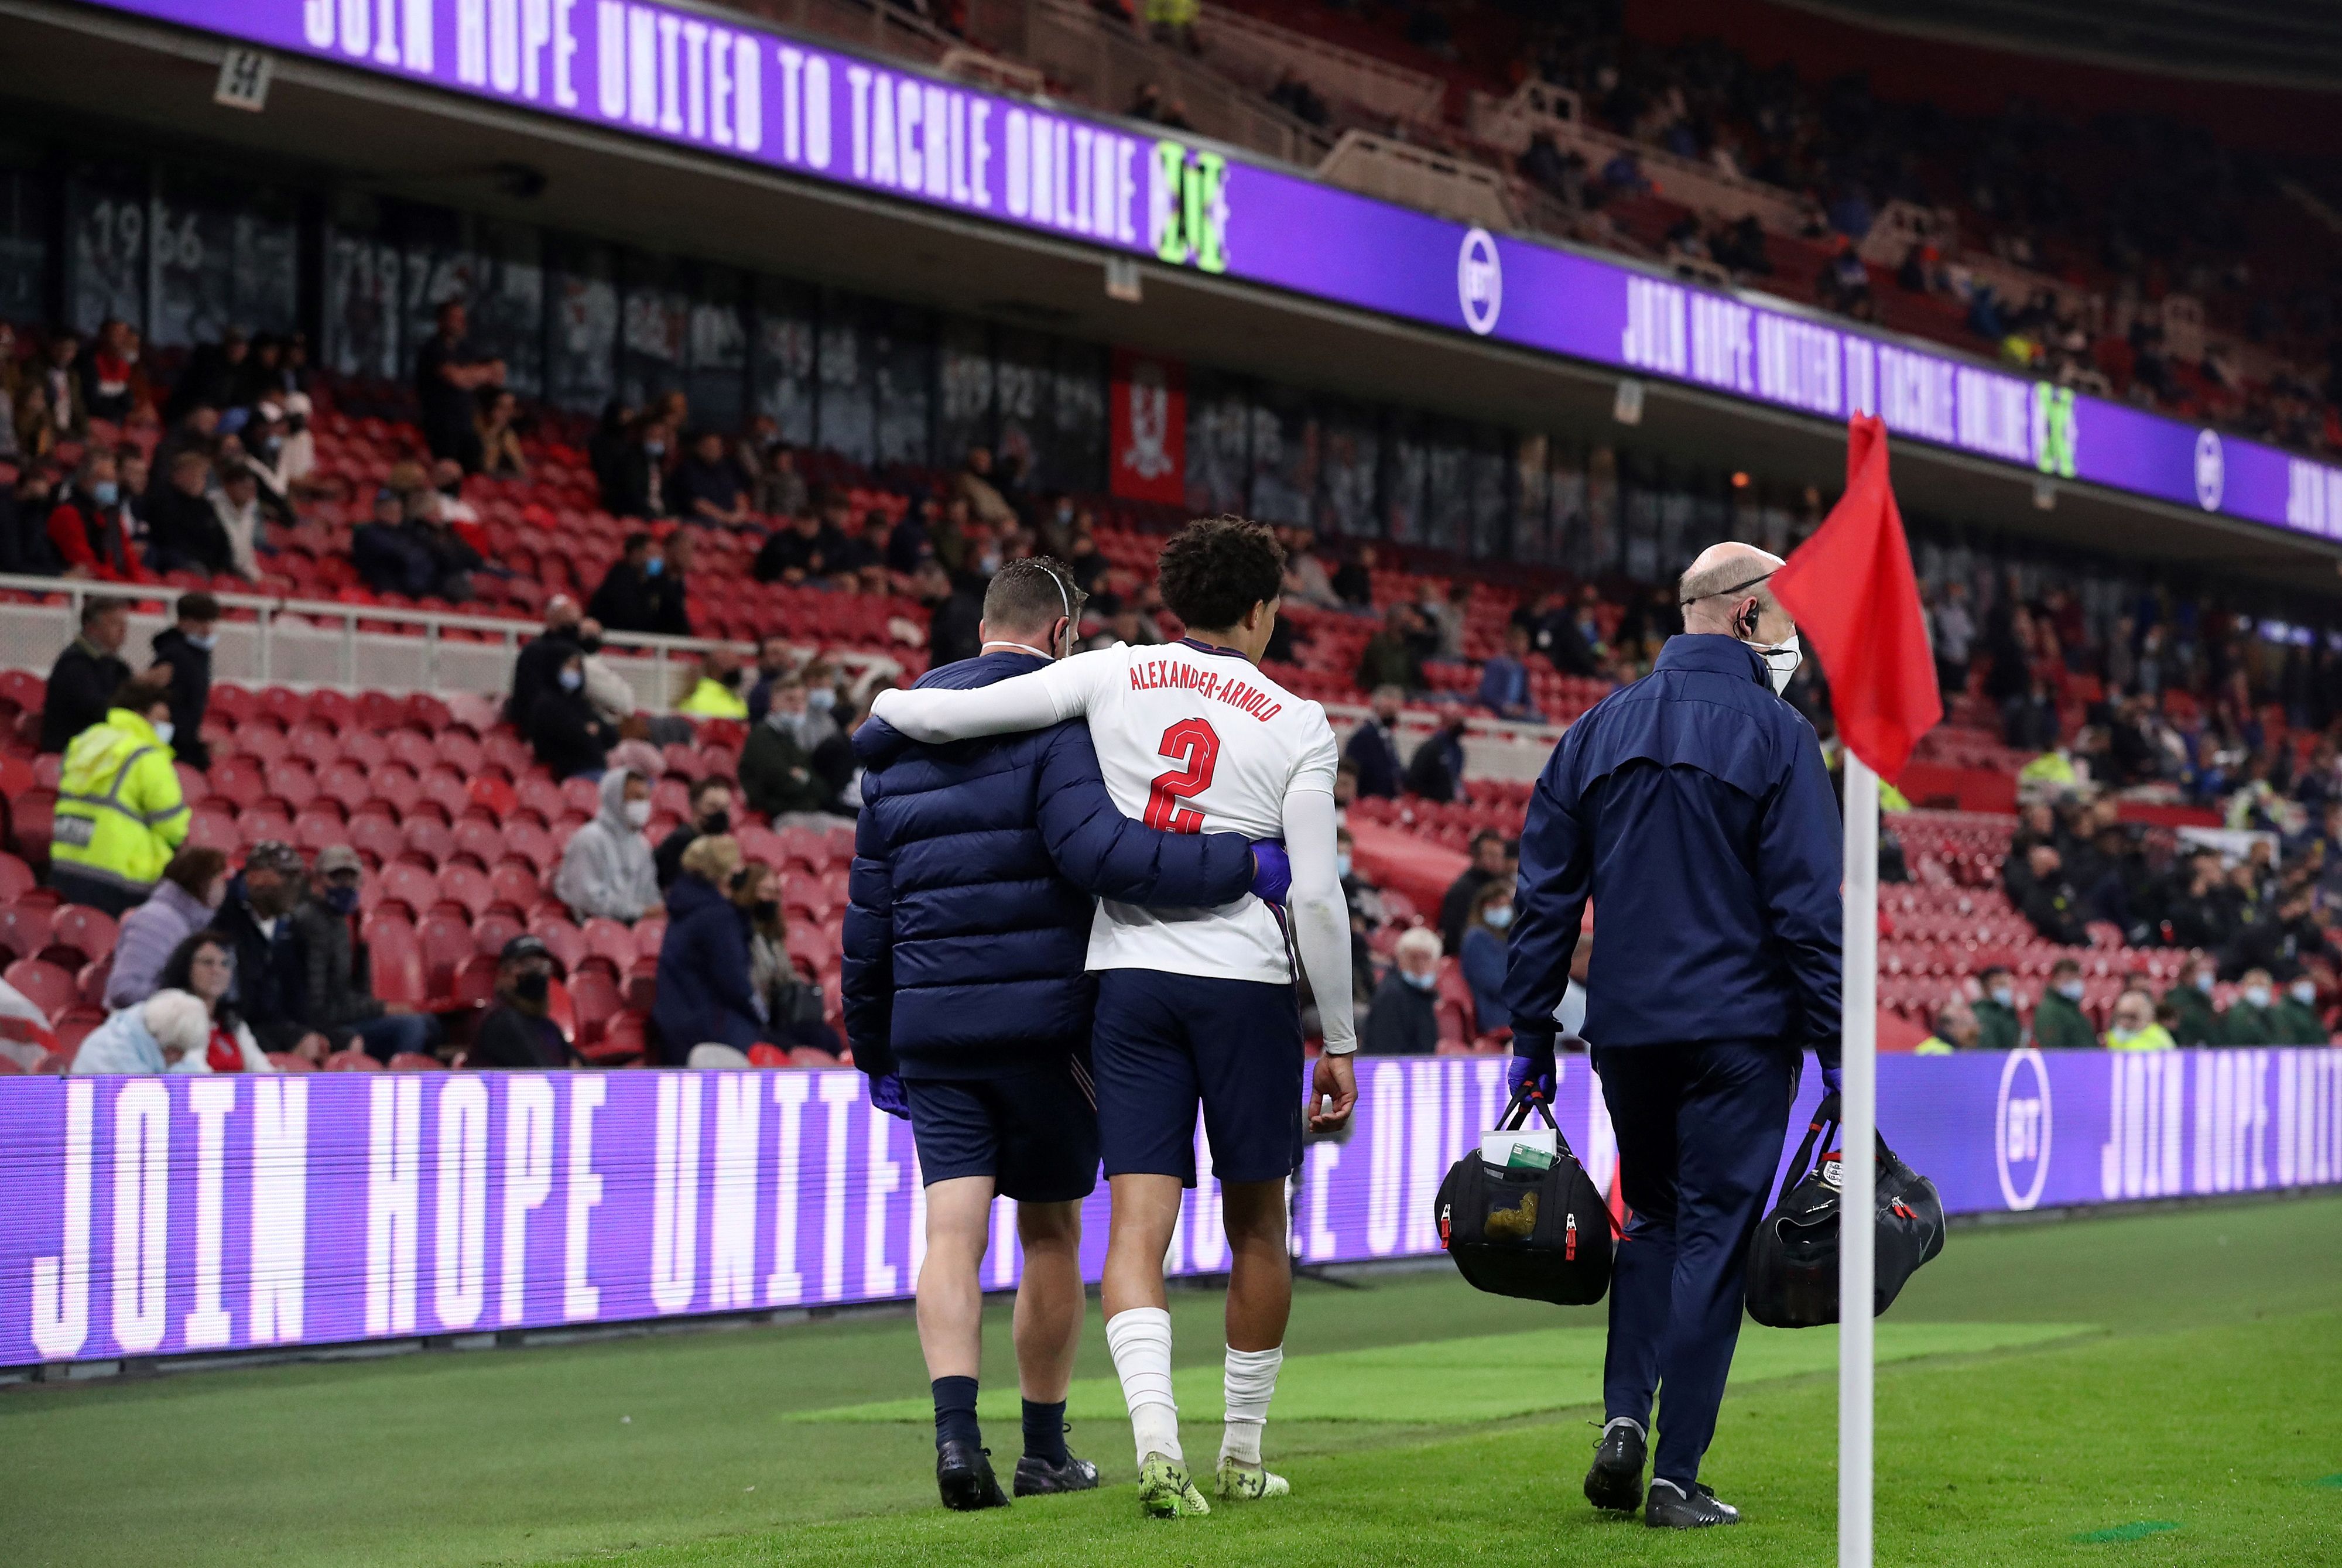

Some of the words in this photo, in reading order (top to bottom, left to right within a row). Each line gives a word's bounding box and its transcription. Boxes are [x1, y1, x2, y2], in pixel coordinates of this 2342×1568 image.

[597, 0, 762, 153] UNITED
[778, 47, 832, 170] TO
[846, 64, 991, 210] TACKLE
[1005, 107, 1137, 245] ONLINE
[1129, 660, 1282, 723] ALEXANDER-ARNOLD
[1142, 717, 1221, 834] 2
[2007, 1097, 2040, 1162] BT
[2101, 1048, 2185, 1201] JOIN
[2193, 1047, 2270, 1195] HOPE
[30, 1075, 310, 1360] JOIN
[364, 1073, 607, 1337] HOPE
